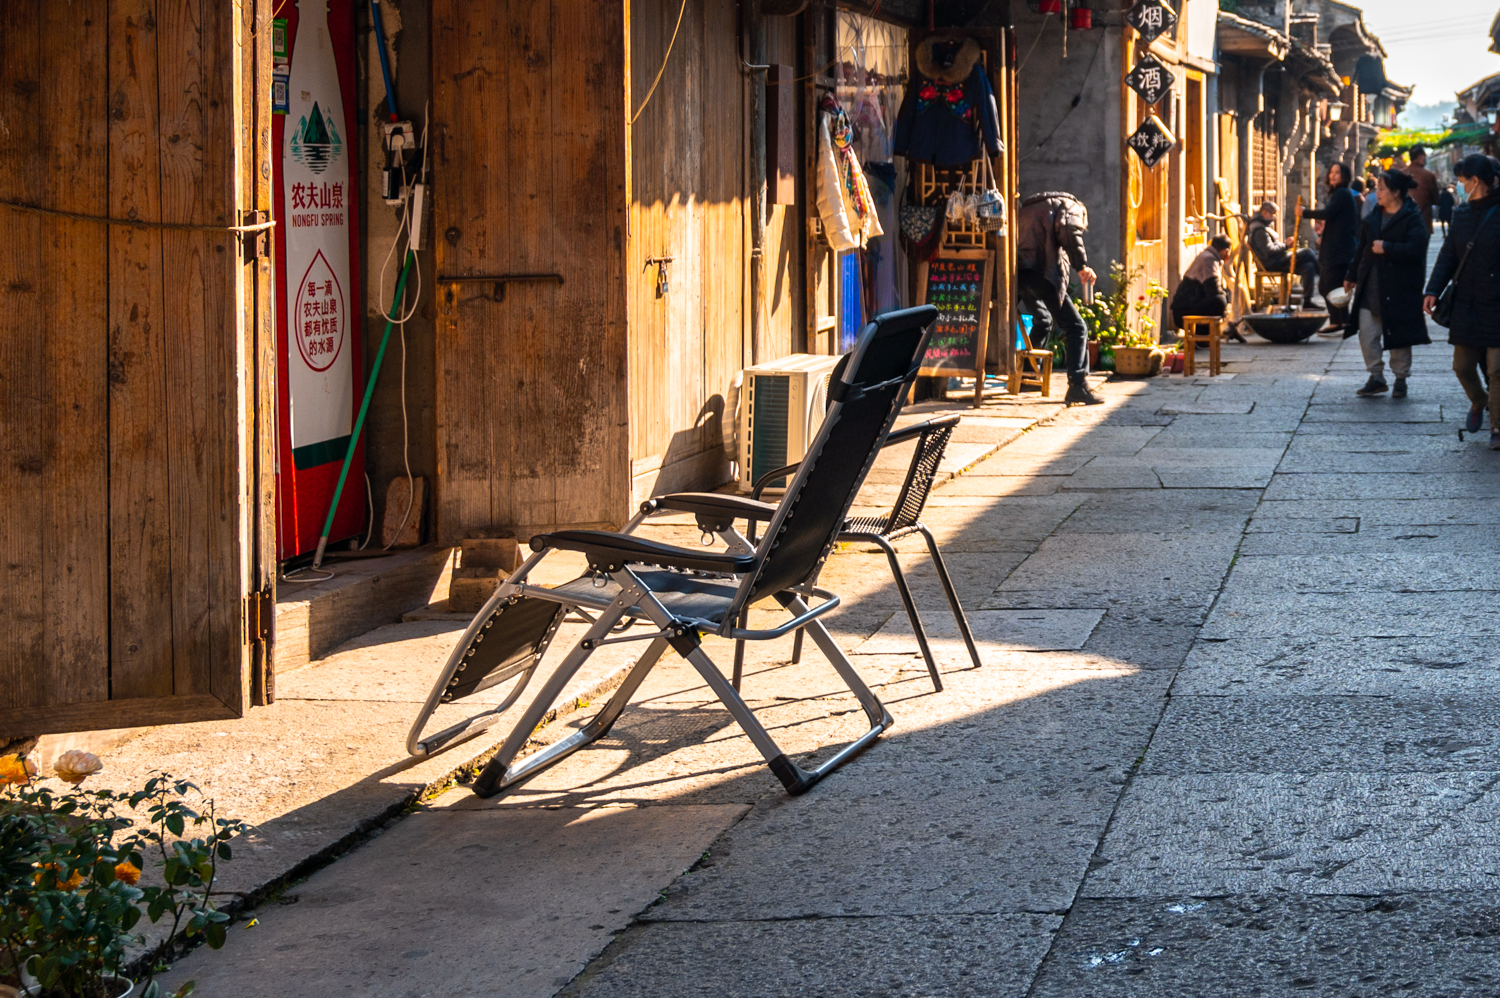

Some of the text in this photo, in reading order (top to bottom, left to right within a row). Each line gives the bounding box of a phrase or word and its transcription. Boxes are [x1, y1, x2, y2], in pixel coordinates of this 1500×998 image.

[1138, 4, 1163, 28] 烟
[1138, 67, 1161, 91] 酒
[1136, 132, 1167, 149] 饮料
[291, 181, 343, 210] 农夫山泉
[292, 212, 344, 227] NONGFU SPRING
[307, 279, 333, 298] 每一滴
[303, 298, 338, 318] 农夫山泉
[304, 317, 338, 338] 都有优质
[308, 336, 335, 357] 的水源
